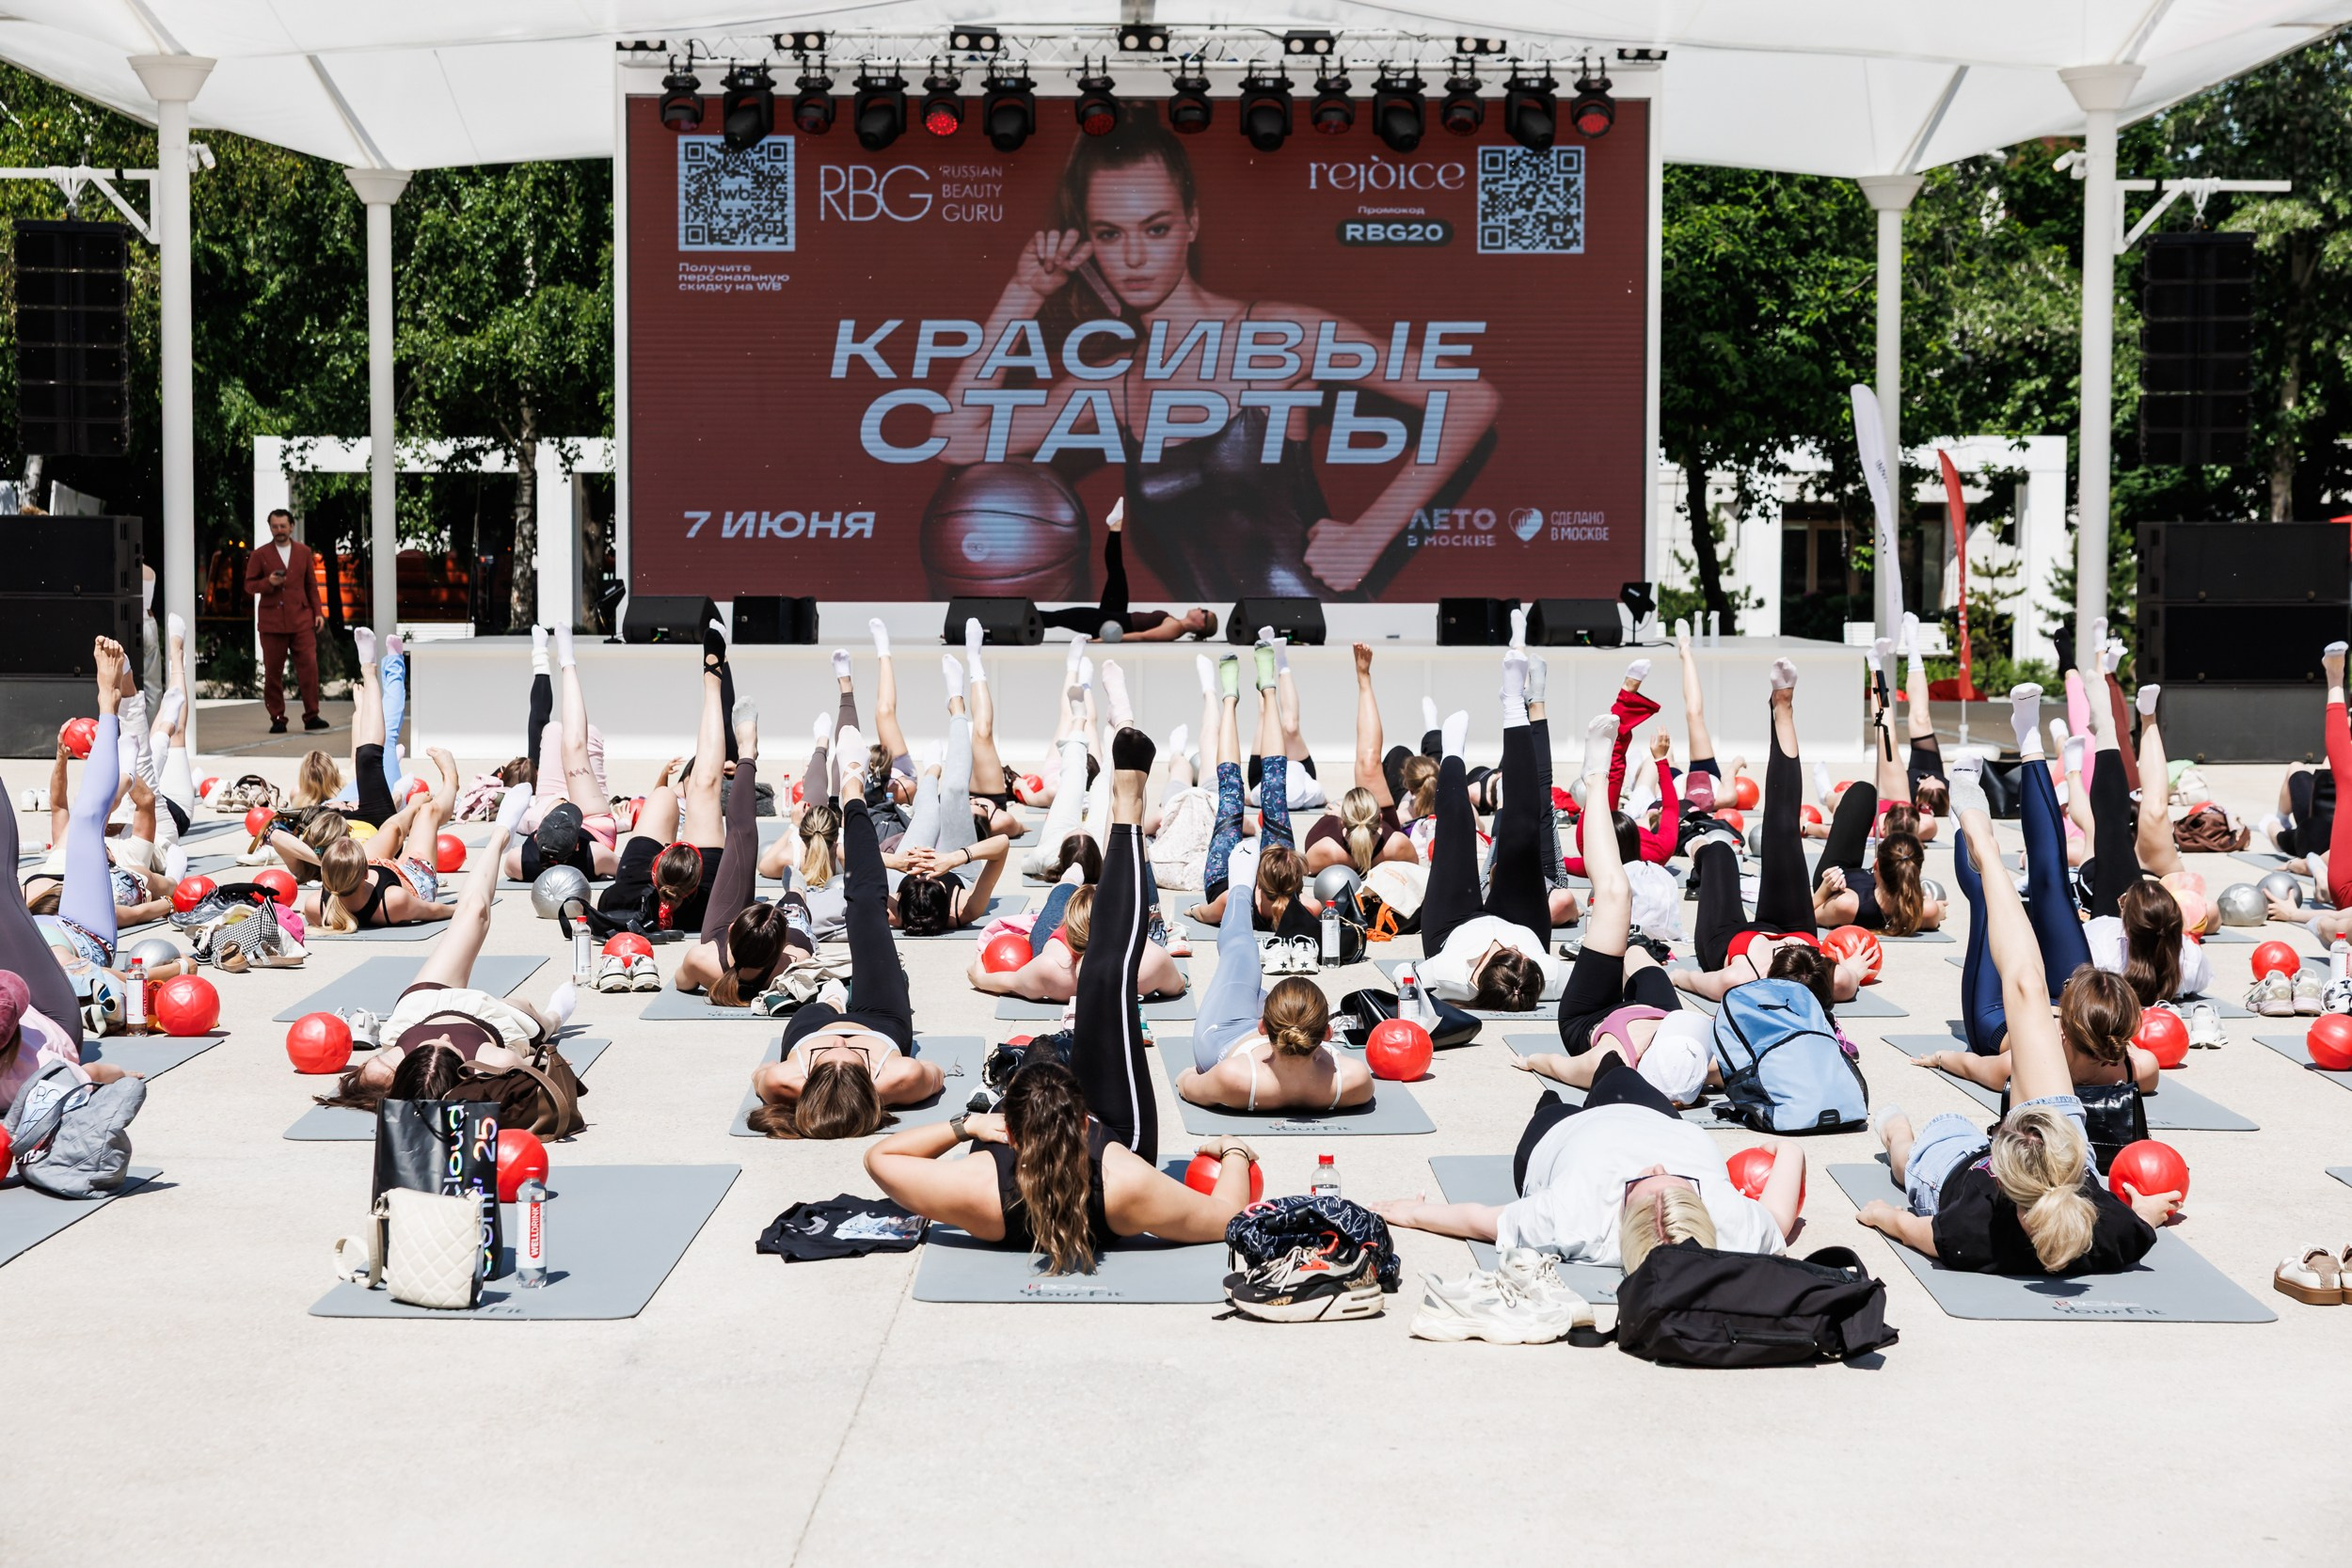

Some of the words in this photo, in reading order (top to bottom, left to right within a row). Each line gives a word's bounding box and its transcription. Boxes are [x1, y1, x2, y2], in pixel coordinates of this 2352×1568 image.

[943, 166, 1003, 178] RUSSIAN
[1309, 155, 1466, 194] rejoice
[820, 165, 933, 222] RBG
[942, 184, 1003, 198] BEAUTY
[942, 203, 1003, 222] GURU
[1358, 205, 1425, 215] Промокод
[1345, 223, 1444, 242] RBG20
[678, 262, 752, 274] Получите
[678, 274, 790, 283] персональную
[679, 282, 732, 293] скидку
[756, 282, 782, 291] WB
[830, 319, 1486, 381] КРАСИВЫЕ
[859, 388, 1450, 465] СТАРТЫ
[683, 511, 711, 539] 7
[721, 511, 876, 539] ИЮНЯ
[1408, 508, 1496, 531] ЛЕТО
[1550, 511, 1604, 527] СДЕЛАНО
[1407, 535, 1418, 546] В
[1424, 534, 1496, 546] МОСКВЕ
[1550, 528, 1558, 541] В
[1561, 527, 1609, 541] МОСКВЕ
[473, 1117, 498, 1163] 25
[531, 1205, 540, 1257] WELLDRINK
